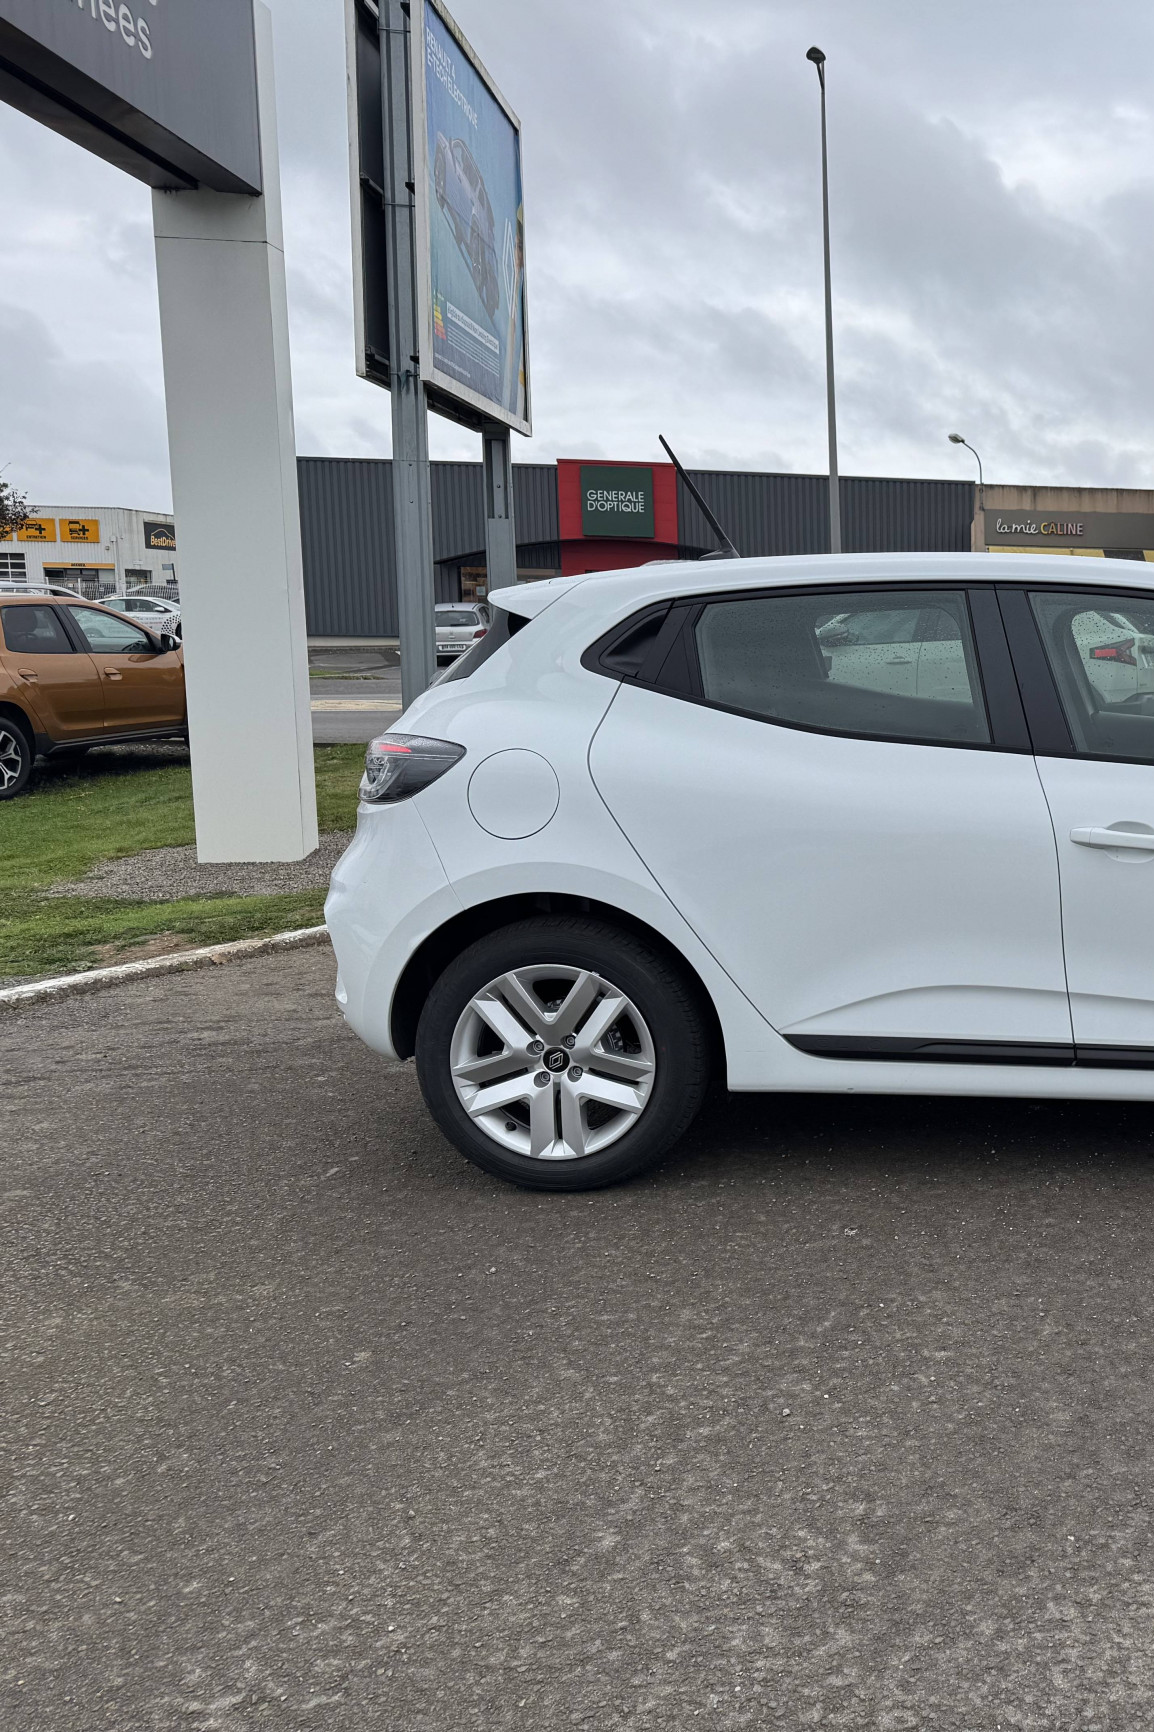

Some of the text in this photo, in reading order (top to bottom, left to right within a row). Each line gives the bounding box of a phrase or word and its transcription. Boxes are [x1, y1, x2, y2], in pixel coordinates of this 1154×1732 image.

[426, 26, 456, 81] RENAULT 4
[426, 46, 448, 89] E-TECH
[587, 489, 645, 502] GENERALE
[587, 501, 645, 513] D'OPTIQUE
[996, 518, 1011, 533] la
[1011, 520, 1039, 534] mie
[150, 535, 176, 548] BestDrive
